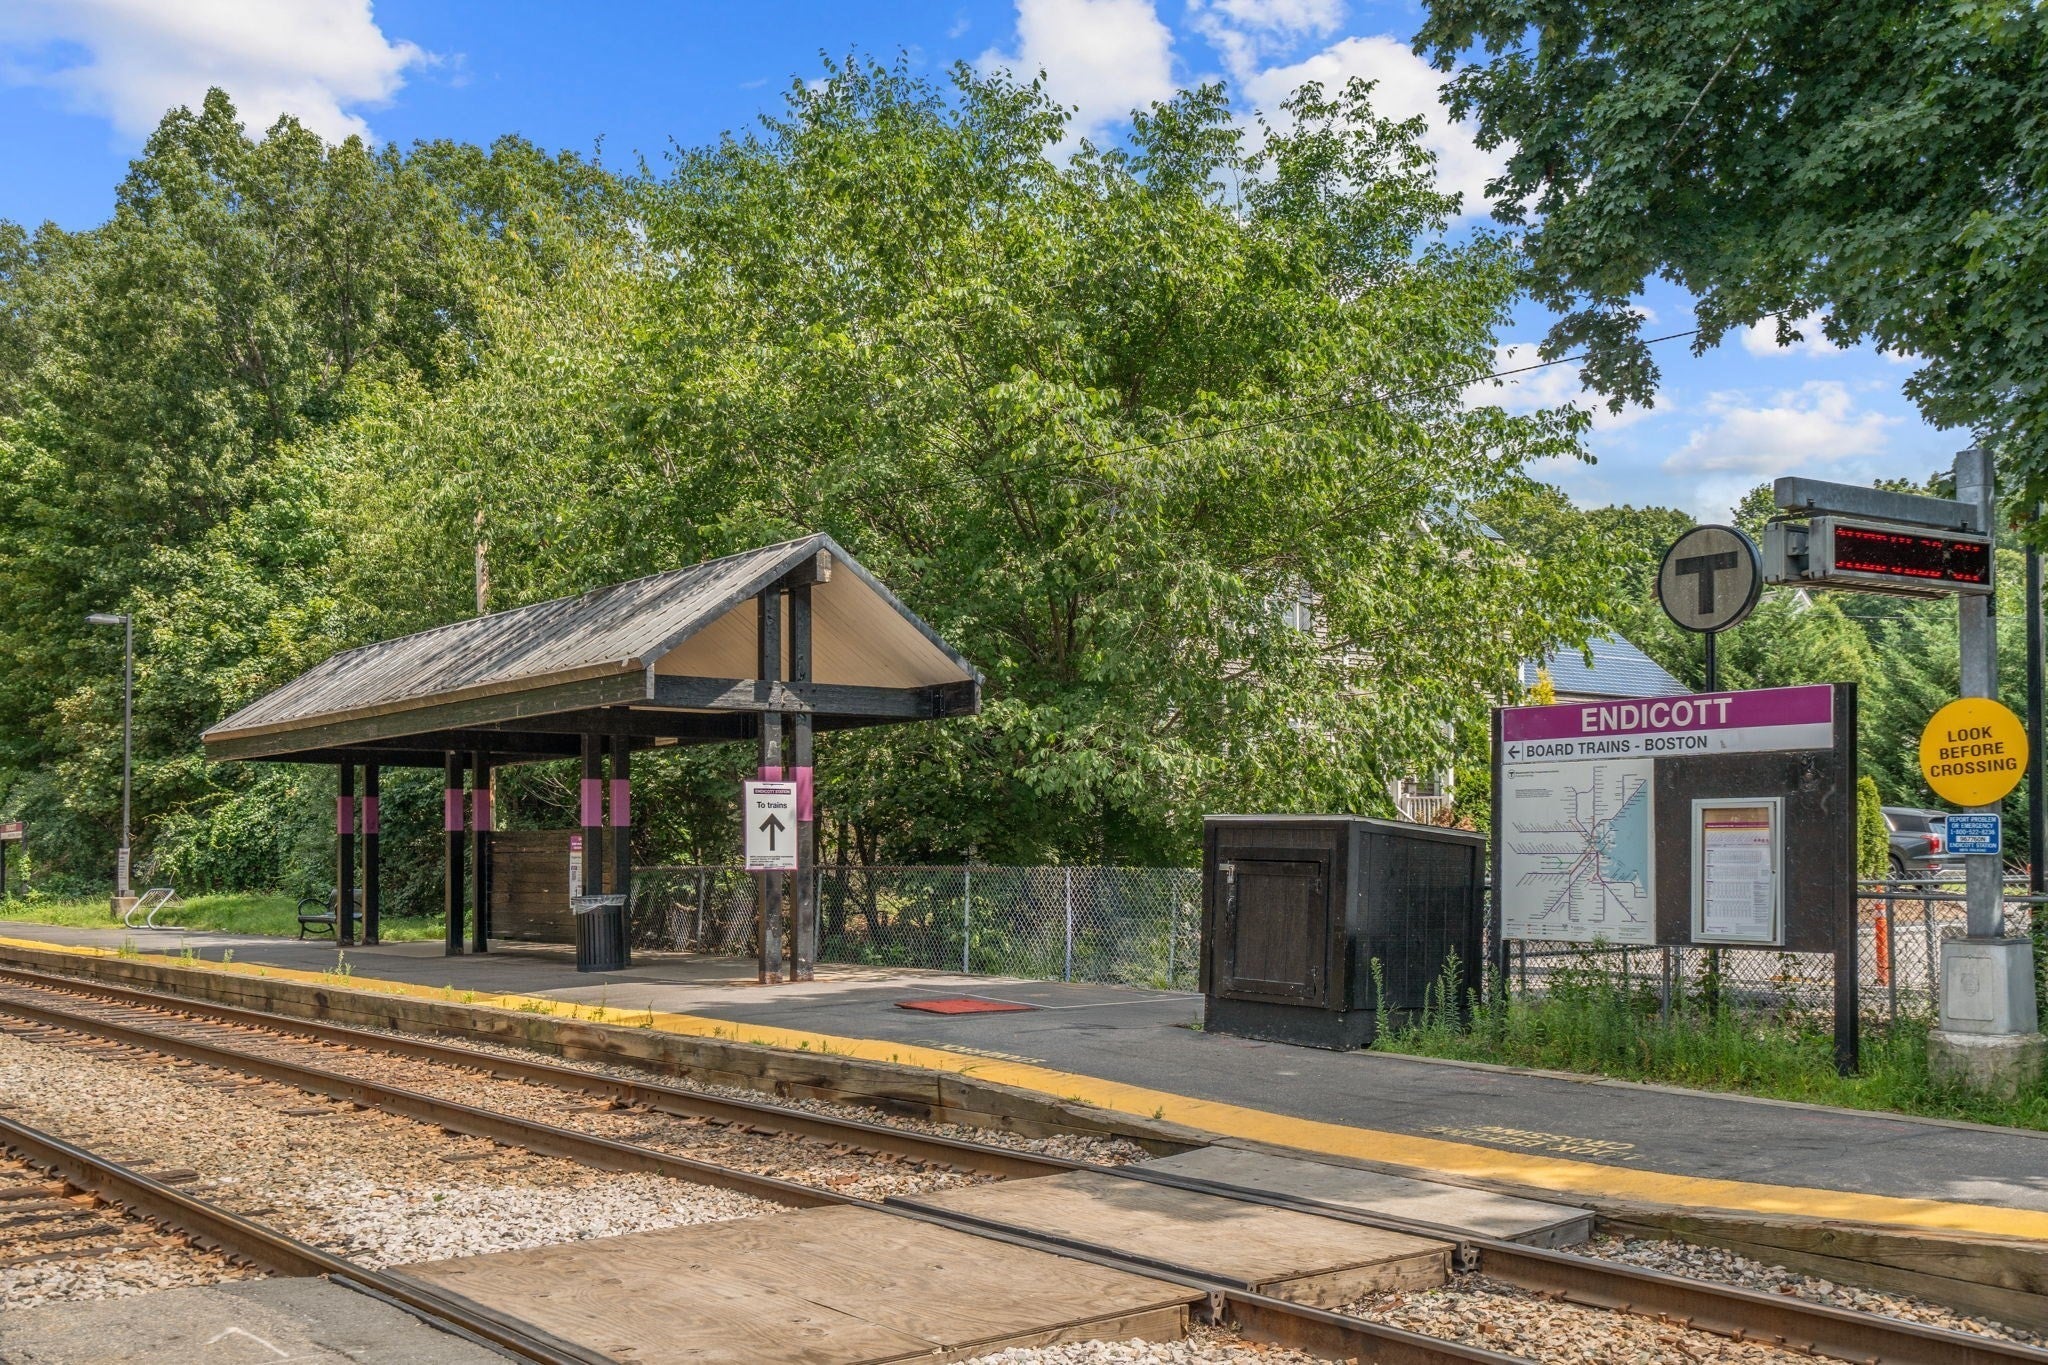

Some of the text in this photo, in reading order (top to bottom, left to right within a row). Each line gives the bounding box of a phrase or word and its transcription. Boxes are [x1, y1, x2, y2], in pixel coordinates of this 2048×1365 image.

[1675, 550, 1738, 615] T
[1581, 697, 1732, 732] ENDICOTT
[1947, 726, 1993, 743] LOOK
[1526, 743, 1574, 758] BOARD
[1577, 740, 1630, 754] TRAINS
[1644, 735, 1708, 752] BOSTON
[1940, 742, 2004, 760] BEFORE
[1930, 757, 2017, 778] CROSSING
[756, 801, 788, 809] To trains
